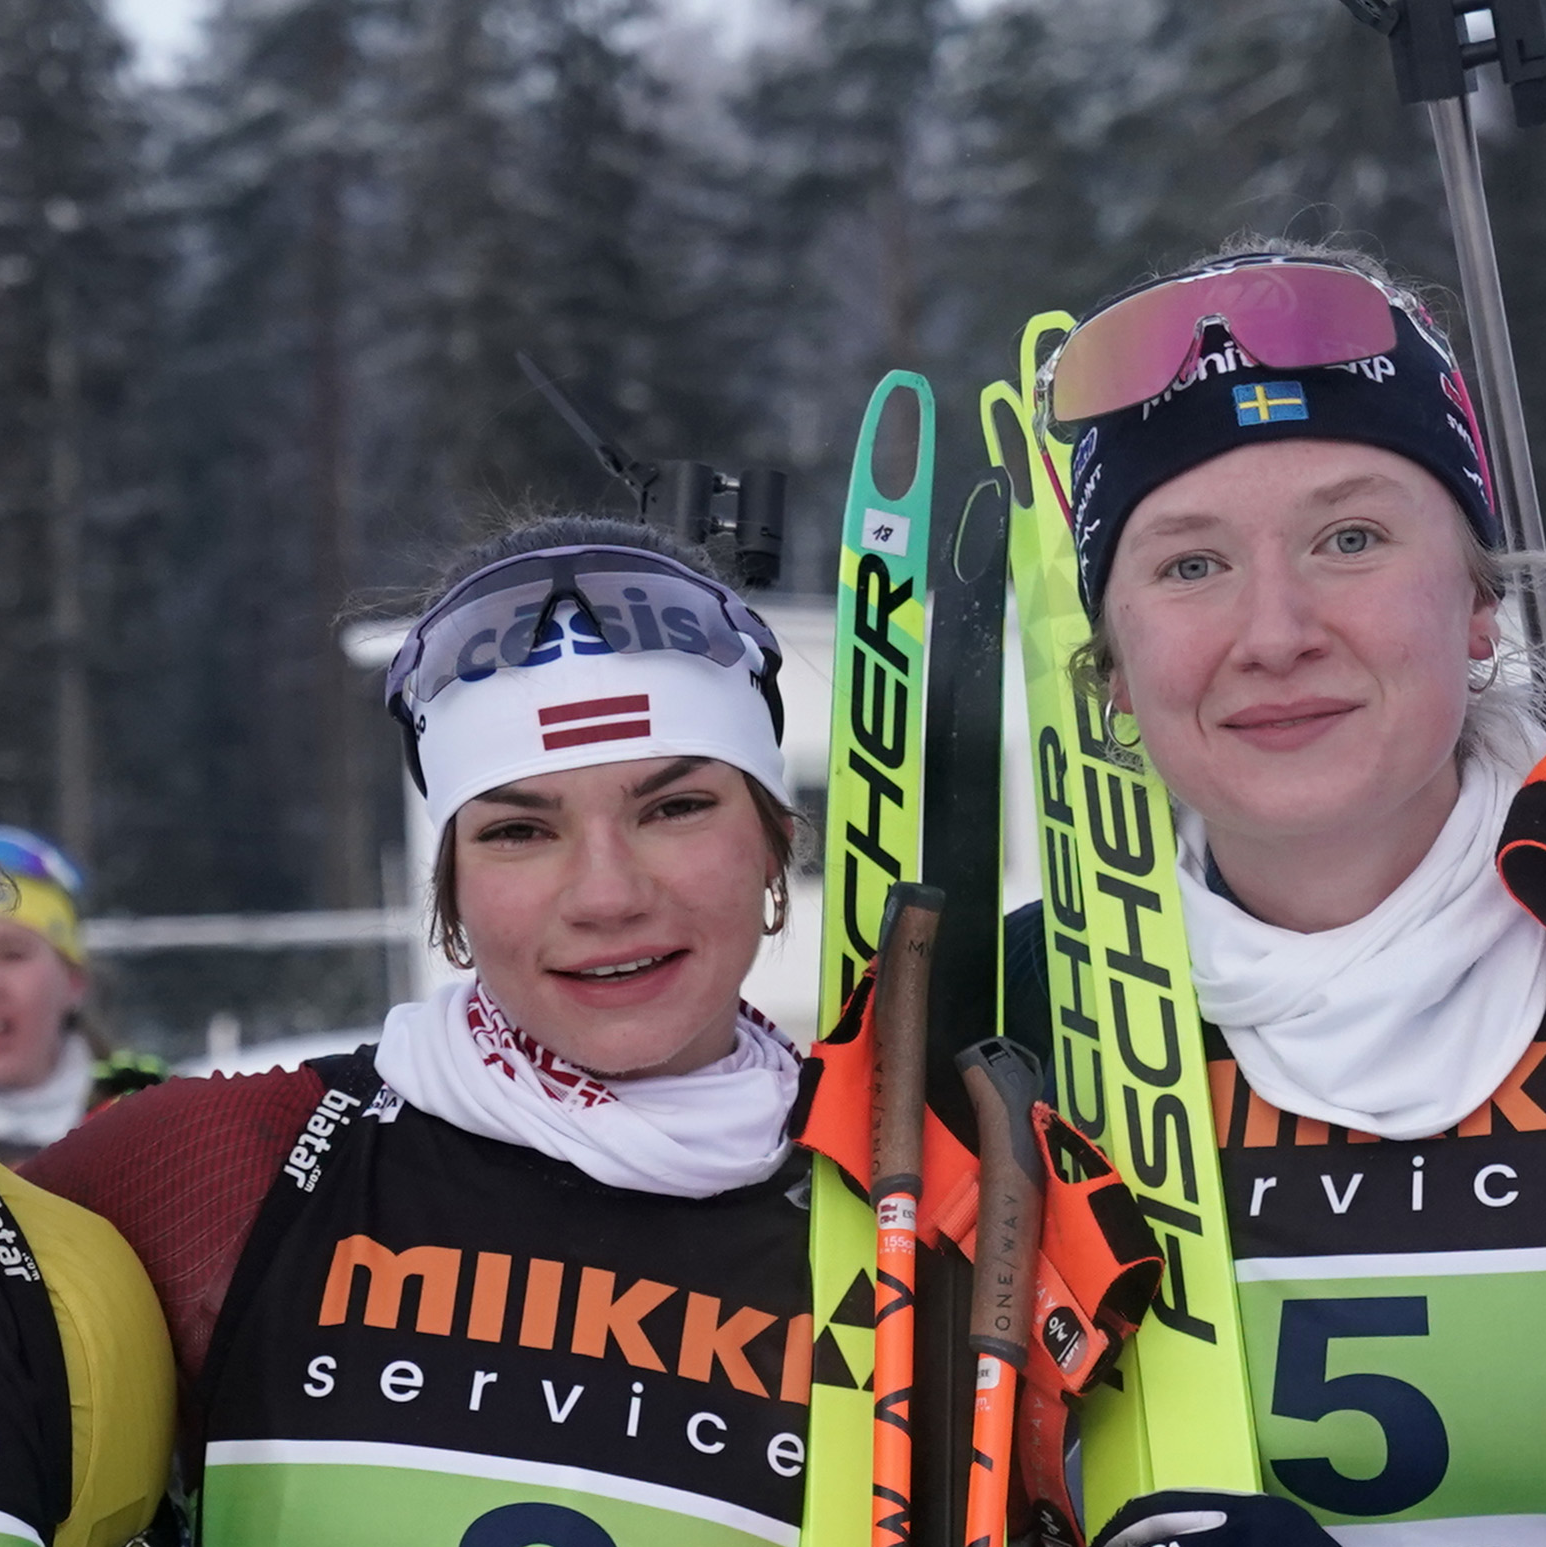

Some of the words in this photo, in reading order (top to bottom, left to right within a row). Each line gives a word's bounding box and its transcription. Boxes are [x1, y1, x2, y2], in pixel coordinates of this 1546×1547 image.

[284, 1088, 362, 1190] biatar
[303, 1164, 323, 1193] .com
[21, 1252, 41, 1282] .com
[994, 1193, 1020, 1332] ONE/WAY
[303, 1353, 807, 1478] service
[1269, 1295, 1451, 1518] 5
